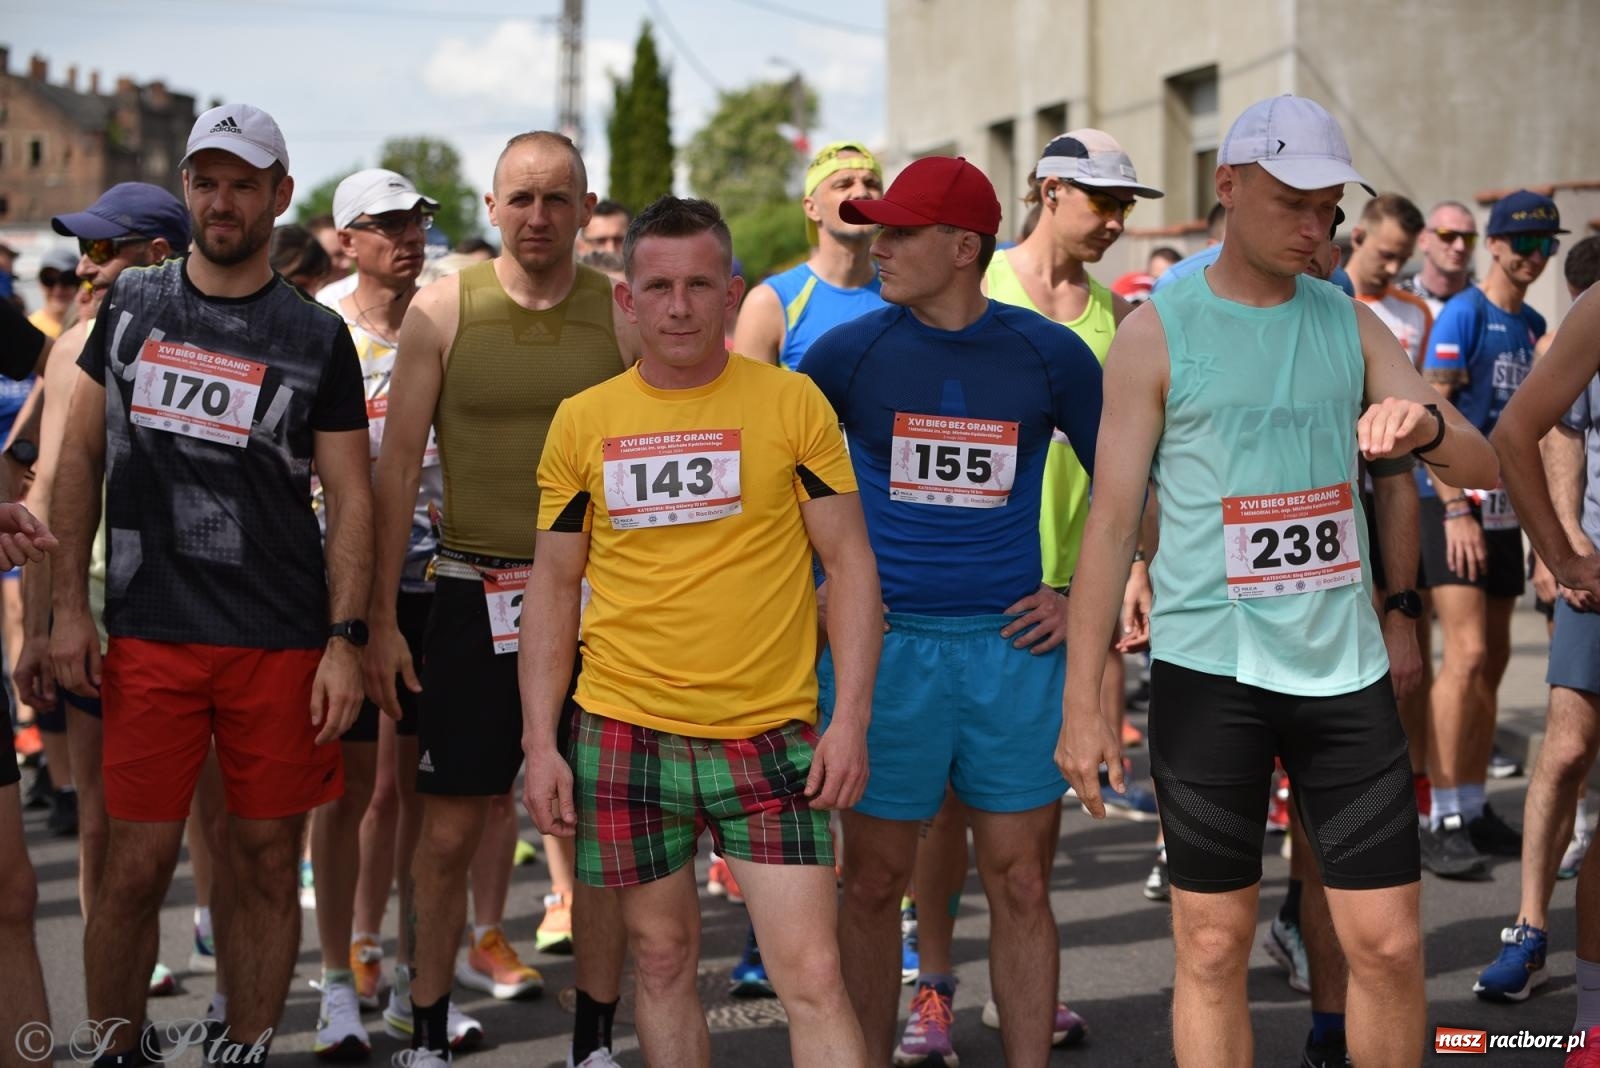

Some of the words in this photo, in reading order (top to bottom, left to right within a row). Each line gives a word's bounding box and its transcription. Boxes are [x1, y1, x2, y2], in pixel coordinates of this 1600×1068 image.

[210, 125, 242, 134] adidas
[158, 346, 174, 354] XVI
[175, 348, 196, 359] BIEG
[196, 352, 213, 363] BEZ
[214, 356, 251, 371] GRANIC
[161, 372, 230, 416] 170
[908, 418, 924, 426] XVI
[926, 420, 947, 428] BIEG
[948, 421, 966, 430] BEZ
[966, 422, 1004, 432] GRANIC
[620, 439, 638, 448] XVI
[640, 436, 661, 446] BIEG
[664, 434, 681, 443] BEZ
[683, 432, 724, 442] GRANIC
[916, 444, 992, 483] 155
[630, 458, 714, 501] 143
[1240, 501, 1258, 510] XVI
[1260, 498, 1286, 508] BIEG
[1287, 496, 1306, 506] BEZ
[1308, 490, 1340, 502] GRANIC
[1251, 520, 1340, 569] 238
[497, 572, 512, 581] XVI
